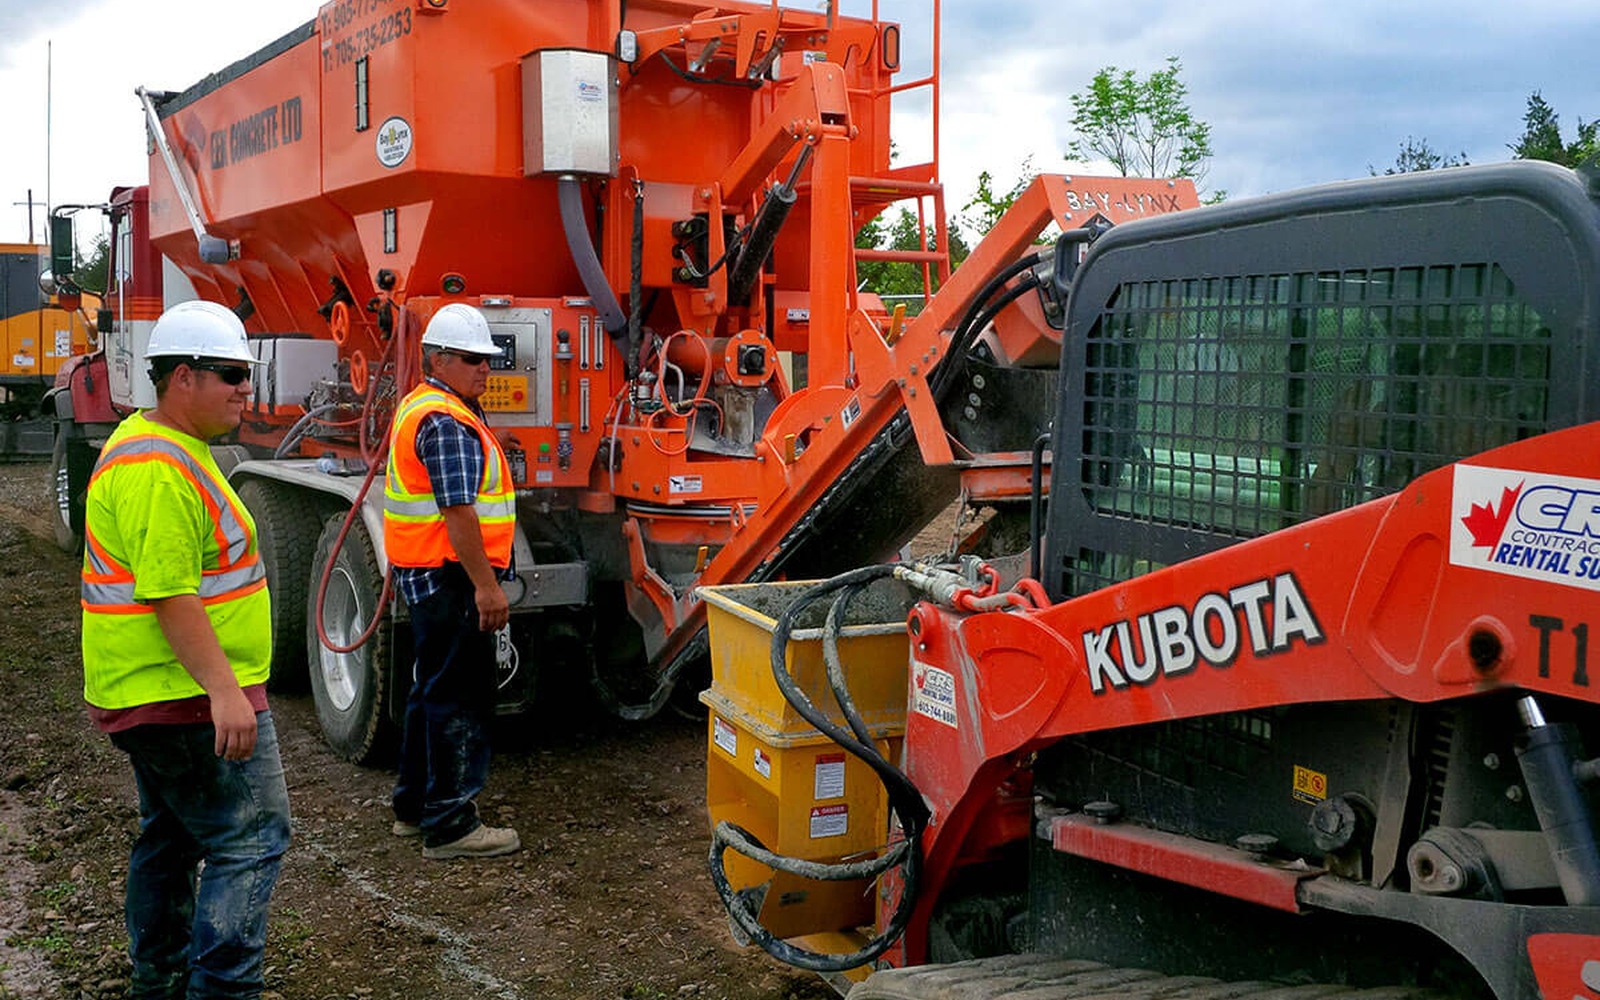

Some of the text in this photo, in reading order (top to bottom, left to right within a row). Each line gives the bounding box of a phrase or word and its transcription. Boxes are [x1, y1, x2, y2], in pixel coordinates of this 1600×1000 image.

[230, 105, 278, 164] CONCRETE
[281, 96, 302, 145] LTD
[1065, 189, 1181, 213] BAY-LYNX
[1495, 542, 1570, 576] RENTAL
[1082, 572, 1323, 692] KUBOTA
